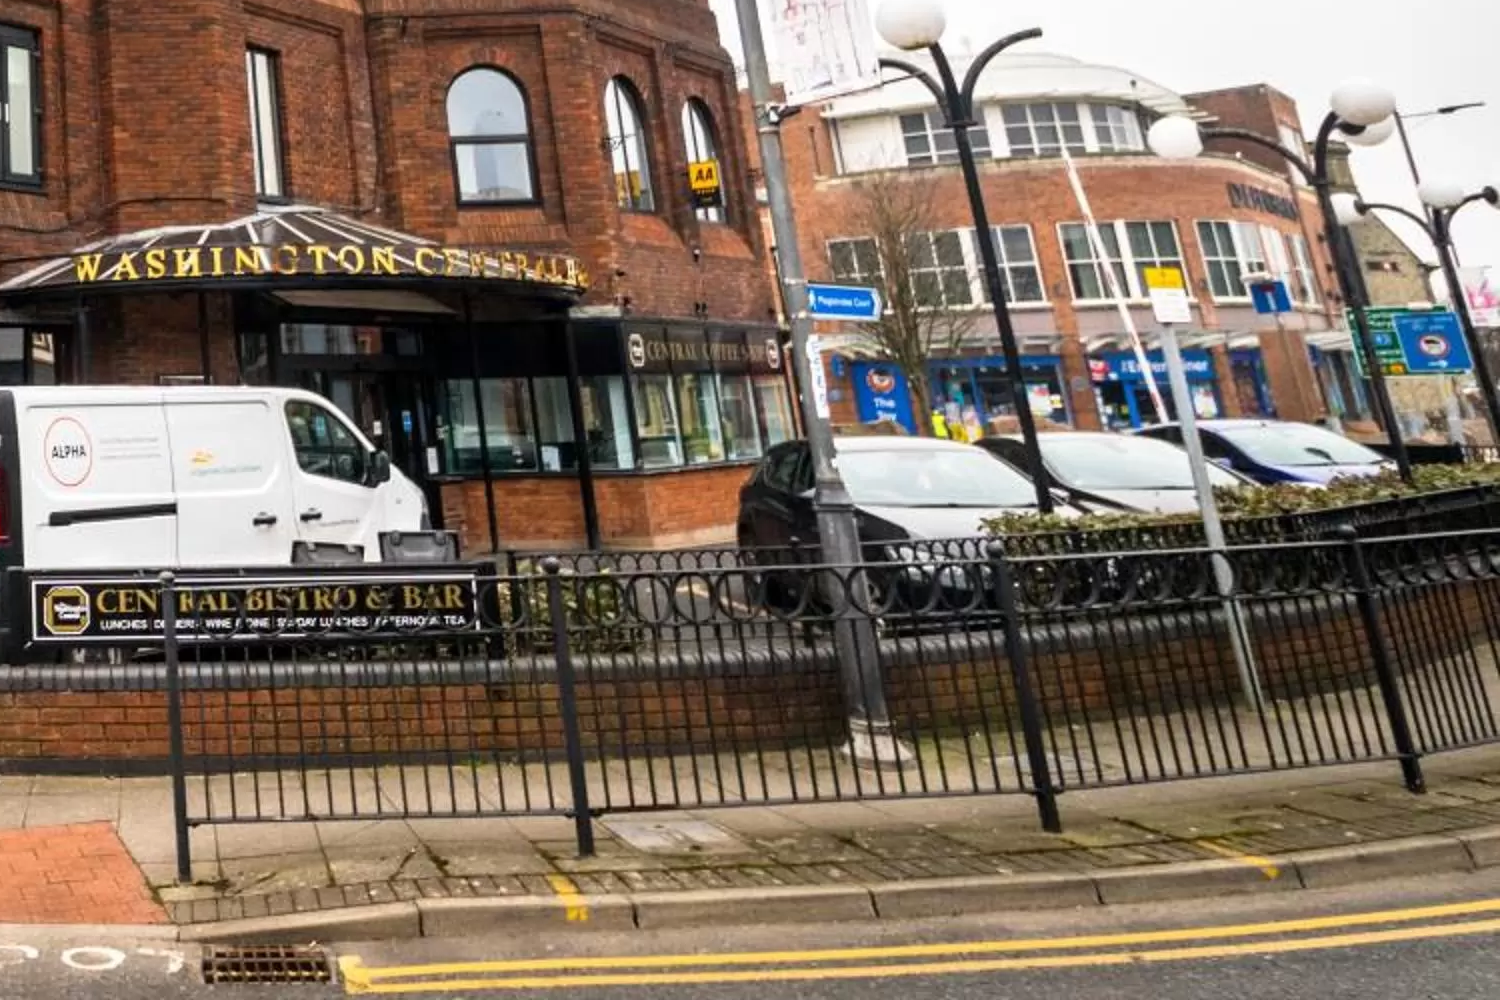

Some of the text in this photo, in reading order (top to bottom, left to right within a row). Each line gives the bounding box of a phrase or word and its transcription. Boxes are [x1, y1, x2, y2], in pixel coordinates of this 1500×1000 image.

[695, 167, 714, 181] AA
[74, 244, 400, 284] WASHINGTON
[414, 246, 562, 284] CENTRAL
[646, 340, 698, 360] CENTRAL
[51, 446, 86, 459] ALPHA
[96, 588, 237, 613] CENRAL
[245, 586, 357, 611] BISTRO
[365, 584, 394, 609] &
[403, 584, 465, 609] BAR
[100, 619, 148, 630] LUNCHES
[205, 617, 231, 629] WINE
[444, 615, 466, 626] TEA
